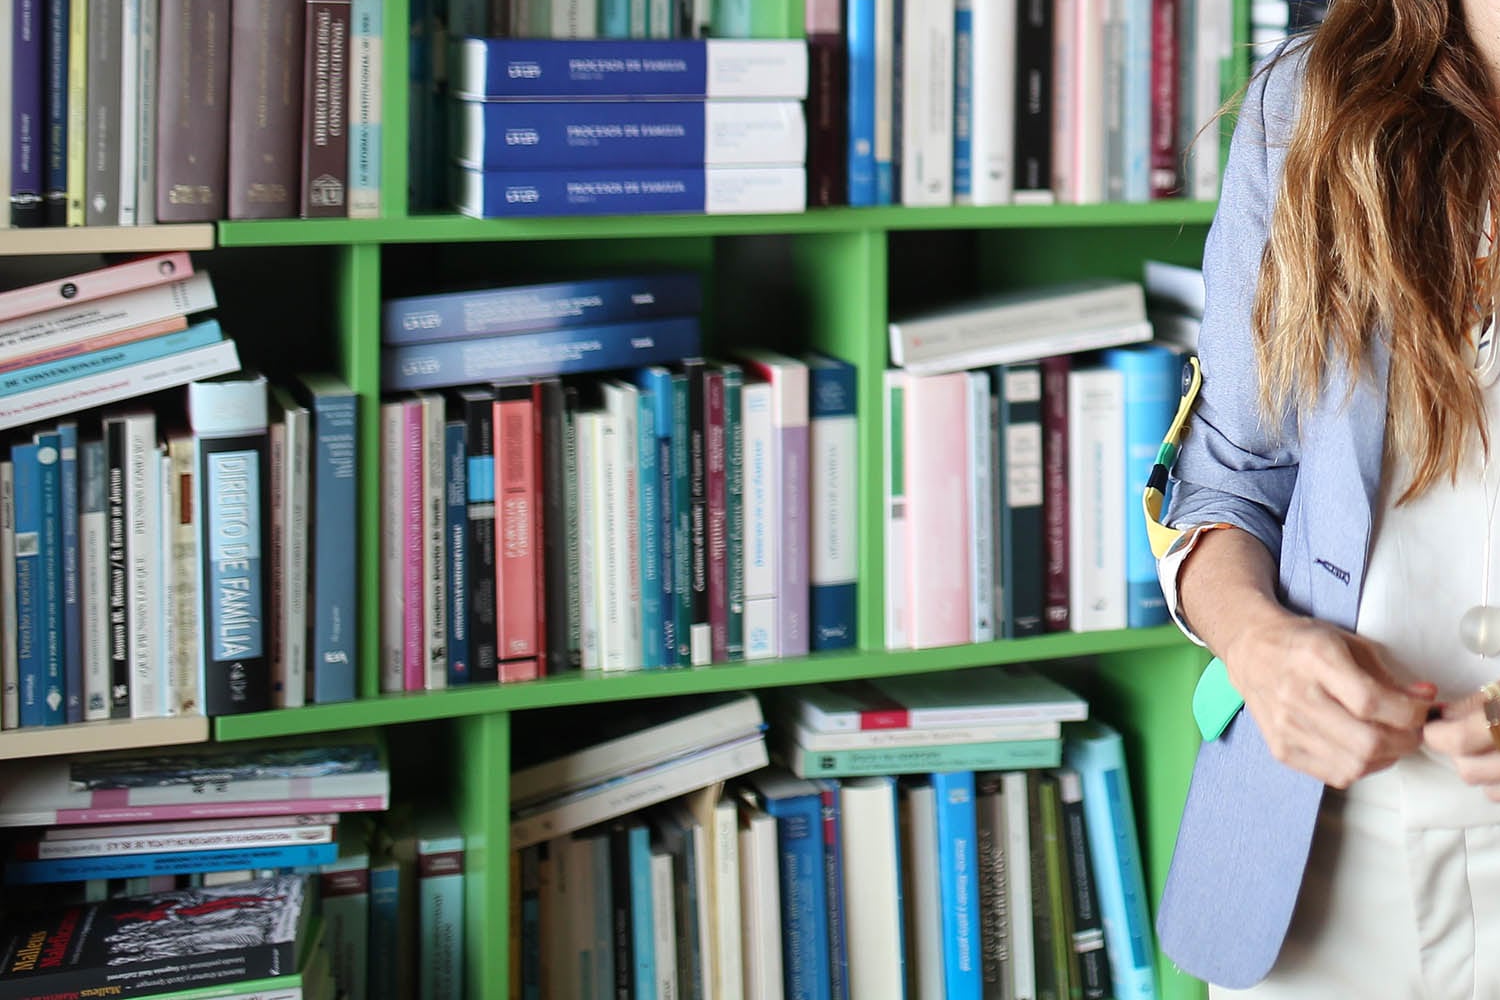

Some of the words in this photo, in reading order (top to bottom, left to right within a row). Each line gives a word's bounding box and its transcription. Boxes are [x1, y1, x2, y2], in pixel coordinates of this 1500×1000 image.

[329, 18, 344, 137] CONSTITUCIONAL
[219, 456, 250, 539] DIREITO
[219, 544, 251, 574] DE
[17, 559, 30, 605] sociedad
[19, 616, 33, 659] Derecho
[218, 577, 259, 658] FAMÍLIA
[996, 920, 1008, 938] LA
[11, 929, 49, 973] Malleus
[998, 943, 1010, 962] DE
[80, 985, 121, 998] Malleus
